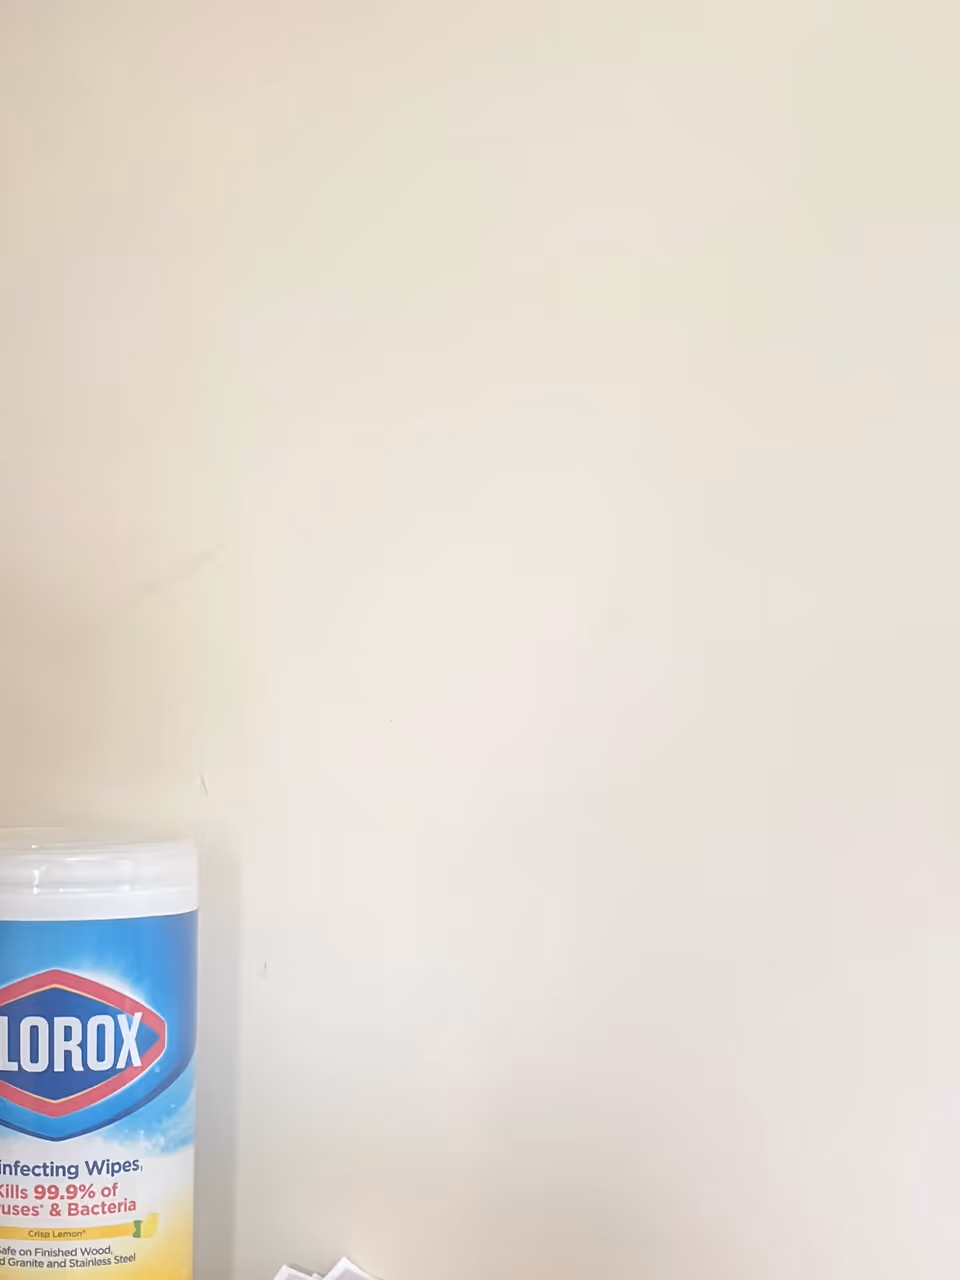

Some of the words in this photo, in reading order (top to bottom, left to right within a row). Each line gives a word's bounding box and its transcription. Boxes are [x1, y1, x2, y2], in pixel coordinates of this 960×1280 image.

[34, 1183, 95, 1200] 99.9%
[101, 1182, 118, 1197] of
[49, 1204, 61, 1216] &
[67, 1199, 136, 1216] Bacteria
[28, 1230, 50, 1239] Crisp
[19, 1248, 32, 1256] on
[34, 1246, 77, 1257] Finished
[8, 1256, 44, 1268] Granite
[47, 1258, 67, 1268] and
[69, 1256, 112, 1268] Stainless
[114, 1253, 136, 1264] Steel
